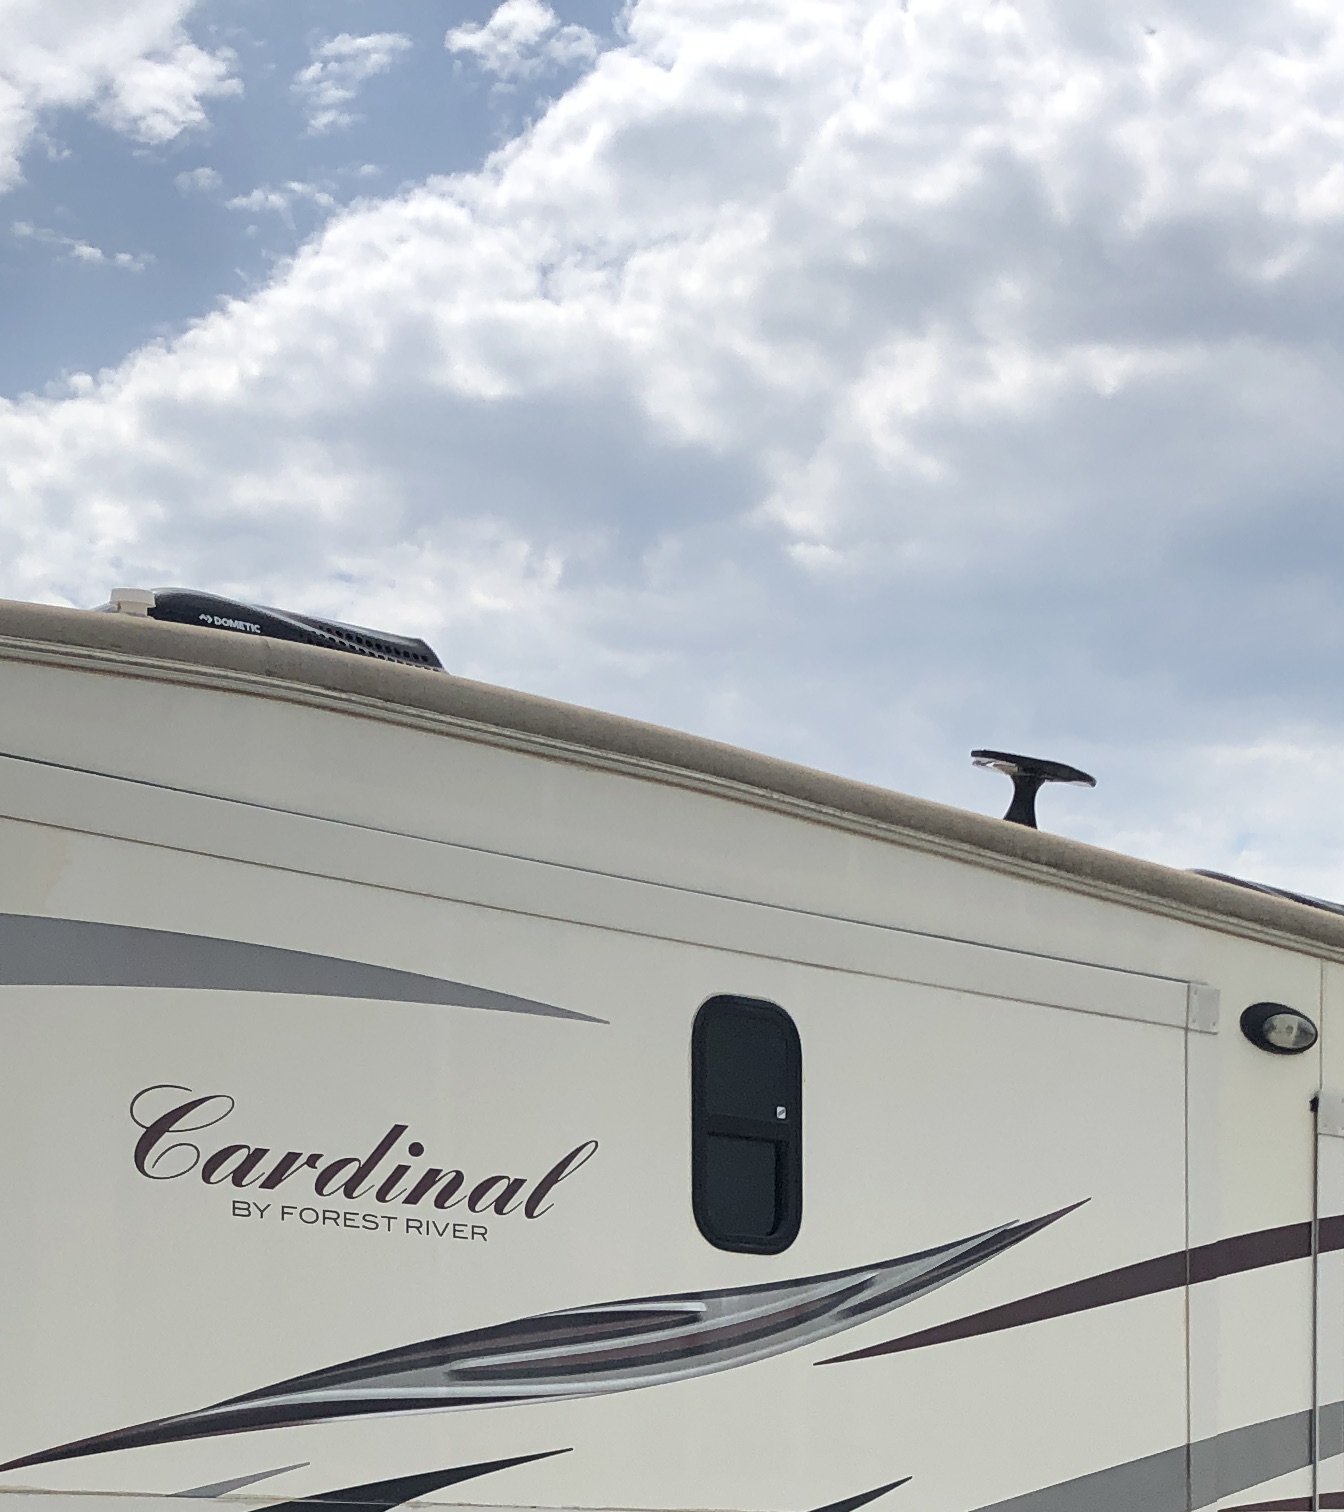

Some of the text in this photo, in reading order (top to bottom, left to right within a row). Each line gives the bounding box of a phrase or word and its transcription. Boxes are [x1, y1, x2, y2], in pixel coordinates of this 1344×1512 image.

[213, 615, 261, 634] DOMETIC
[129, 1084, 599, 1220] Cardinal
[231, 1200, 489, 1242] BY FOREST RIVER
